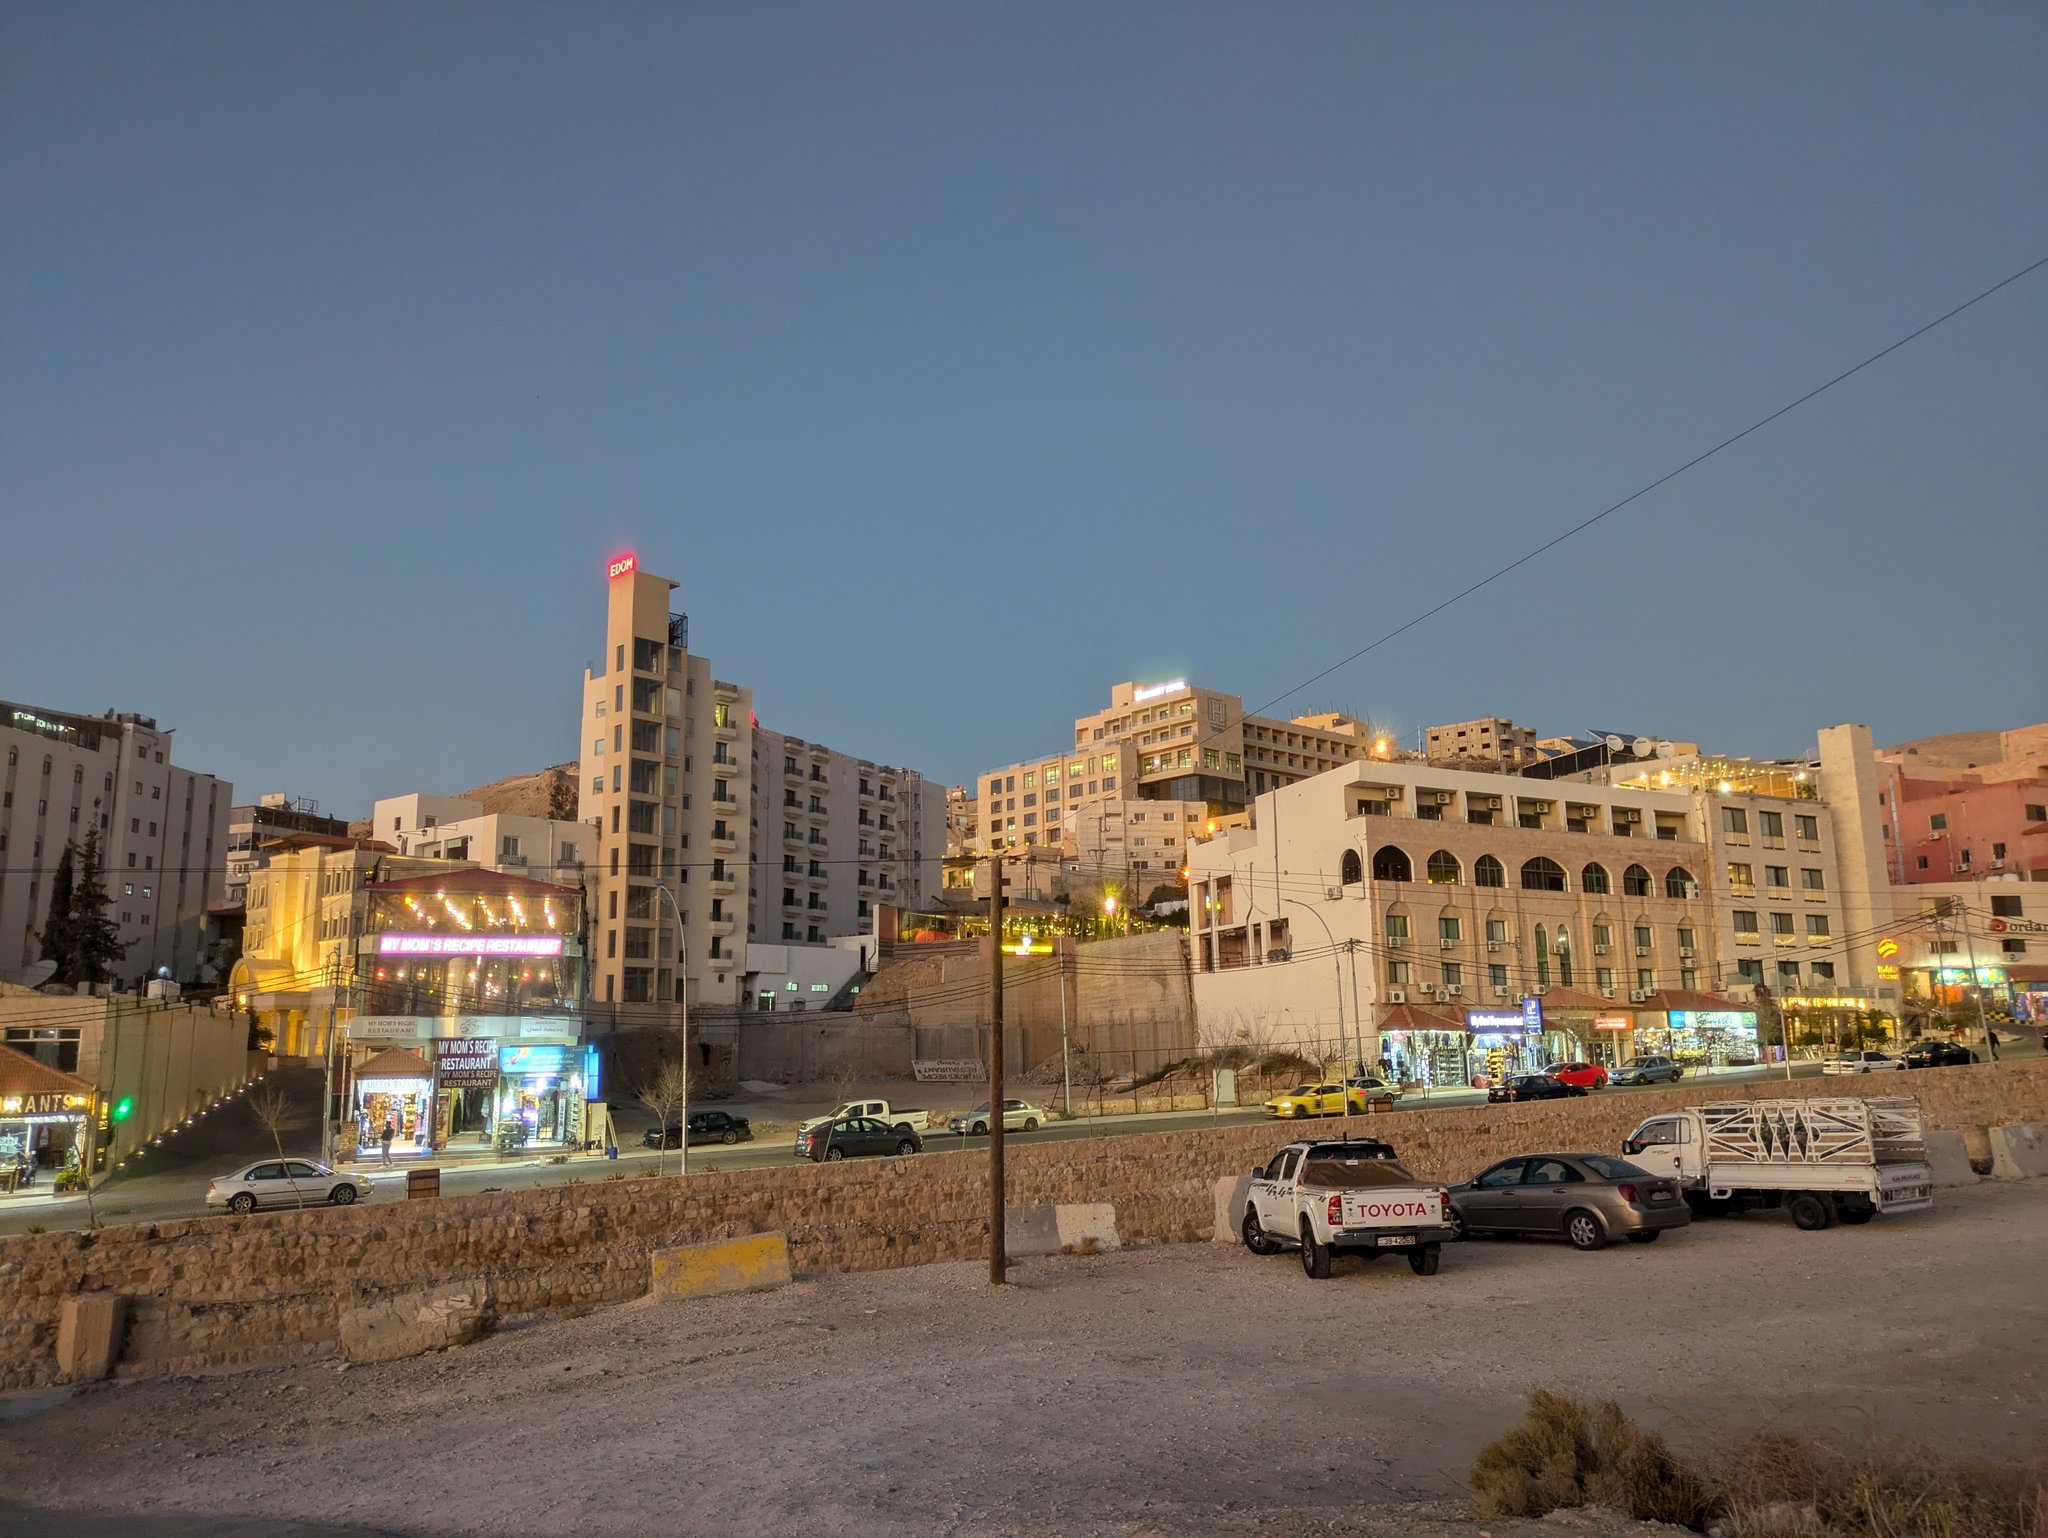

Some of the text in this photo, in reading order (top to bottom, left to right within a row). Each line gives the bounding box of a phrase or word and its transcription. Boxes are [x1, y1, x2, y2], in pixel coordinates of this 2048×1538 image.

[610, 557, 633, 577] EDOM
[381, 937, 562, 953] MY MOM'S RECIPE RESTAURANT
[438, 1040, 497, 1055] MY MOM'S RECIPE
[441, 1058, 491, 1070] RESTAURANT
[441, 1070, 497, 1079] MY MOM'S RECIPE
[443, 1079, 493, 1087] RESTAURANT
[1357, 1203, 1427, 1217] TOYOTA
